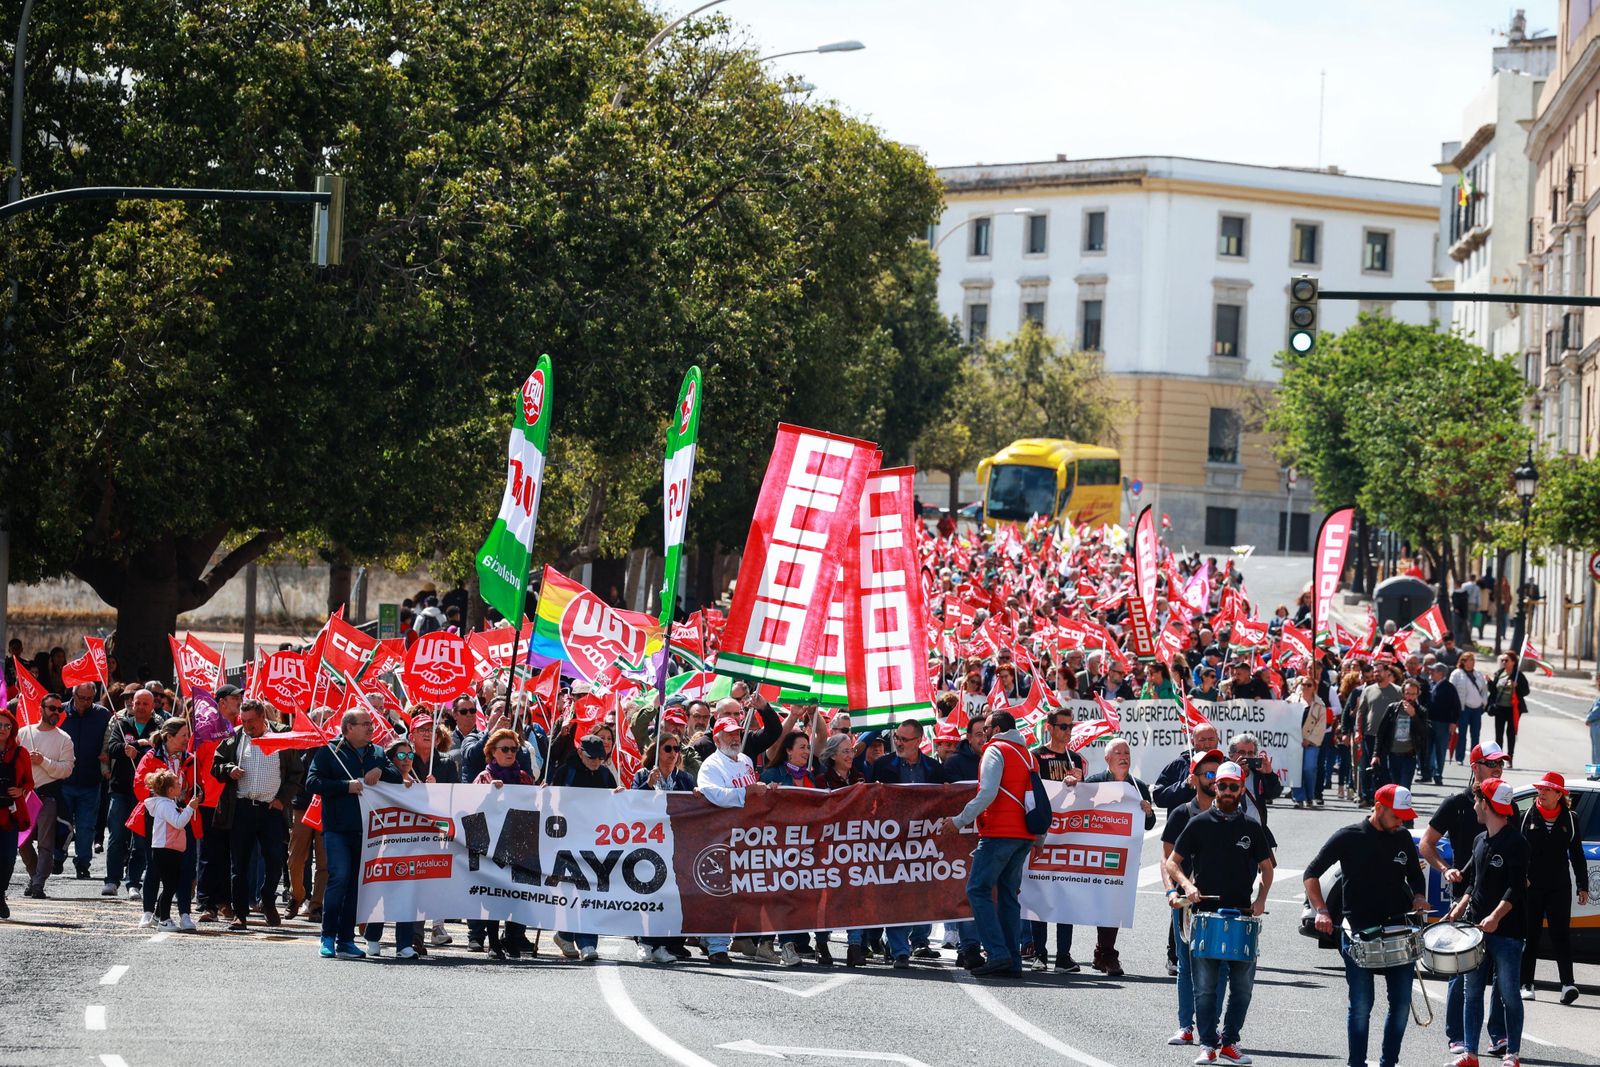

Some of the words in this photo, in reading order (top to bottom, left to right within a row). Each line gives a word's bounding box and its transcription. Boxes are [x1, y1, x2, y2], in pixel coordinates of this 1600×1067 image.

[742, 433, 854, 663] CCOO
[1316, 524, 1345, 624] CCOO
[860, 475, 915, 705] CCOO
[1130, 600, 1151, 653] CCOO
[332, 631, 373, 664] CCO
[415, 638, 465, 667] UGT
[268, 655, 306, 682] UGT
[274, 696, 305, 707] Andaluía
[418, 683, 457, 695] Andalucía
[1077, 703, 1122, 723] GRANS
[1125, 705, 1180, 723] SUPERFICI
[1142, 730, 1150, 746] Y
[371, 811, 434, 832] CCOO
[595, 821, 666, 847] 2024
[729, 826, 778, 848] POR
[785, 825, 815, 845] EL
[820, 819, 900, 843] PLENO
[1049, 816, 1069, 830] GT
[1091, 814, 1129, 826] Andalucía
[383, 835, 420, 846] provincial
[420, 835, 431, 843] de
[730, 847, 815, 871] MENOS
[821, 837, 945, 866] JORNADA,
[365, 862, 393, 879] UGT
[416, 858, 449, 868] Andalucía
[731, 867, 842, 895] MEJORES
[849, 858, 967, 886] SALARIOS
[1028, 873, 1051, 881] unión
[1051, 875, 1091, 885] provincial
[1092, 877, 1102, 885] de
[469, 884, 568, 907] #PLENOEMPLEO
[580, 897, 665, 913] #1MAYO2024
